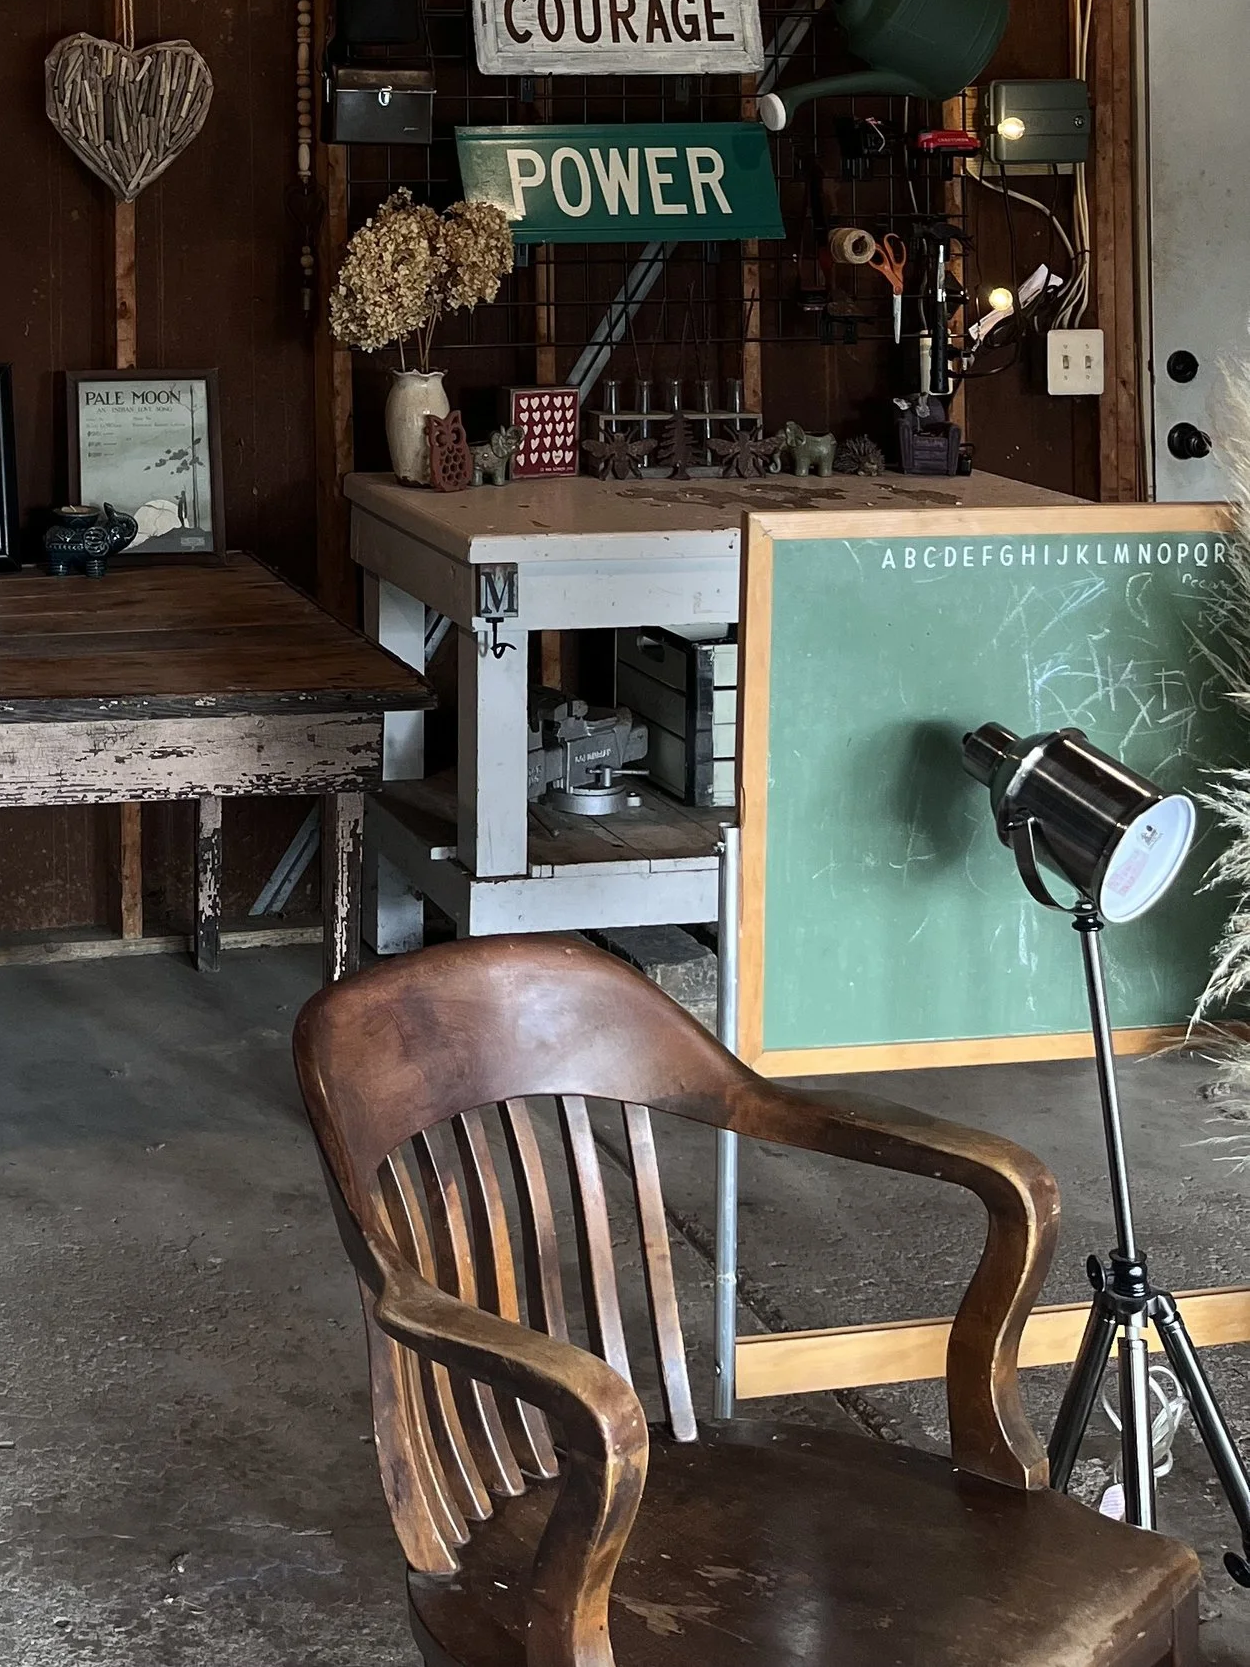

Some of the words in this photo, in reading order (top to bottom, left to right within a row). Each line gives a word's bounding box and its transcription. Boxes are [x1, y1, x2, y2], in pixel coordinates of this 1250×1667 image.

[506, 146, 733, 218] POWER
[85, 391, 125, 406] PALE
[131, 390, 181, 405] MOON
[481, 570, 518, 614] M
